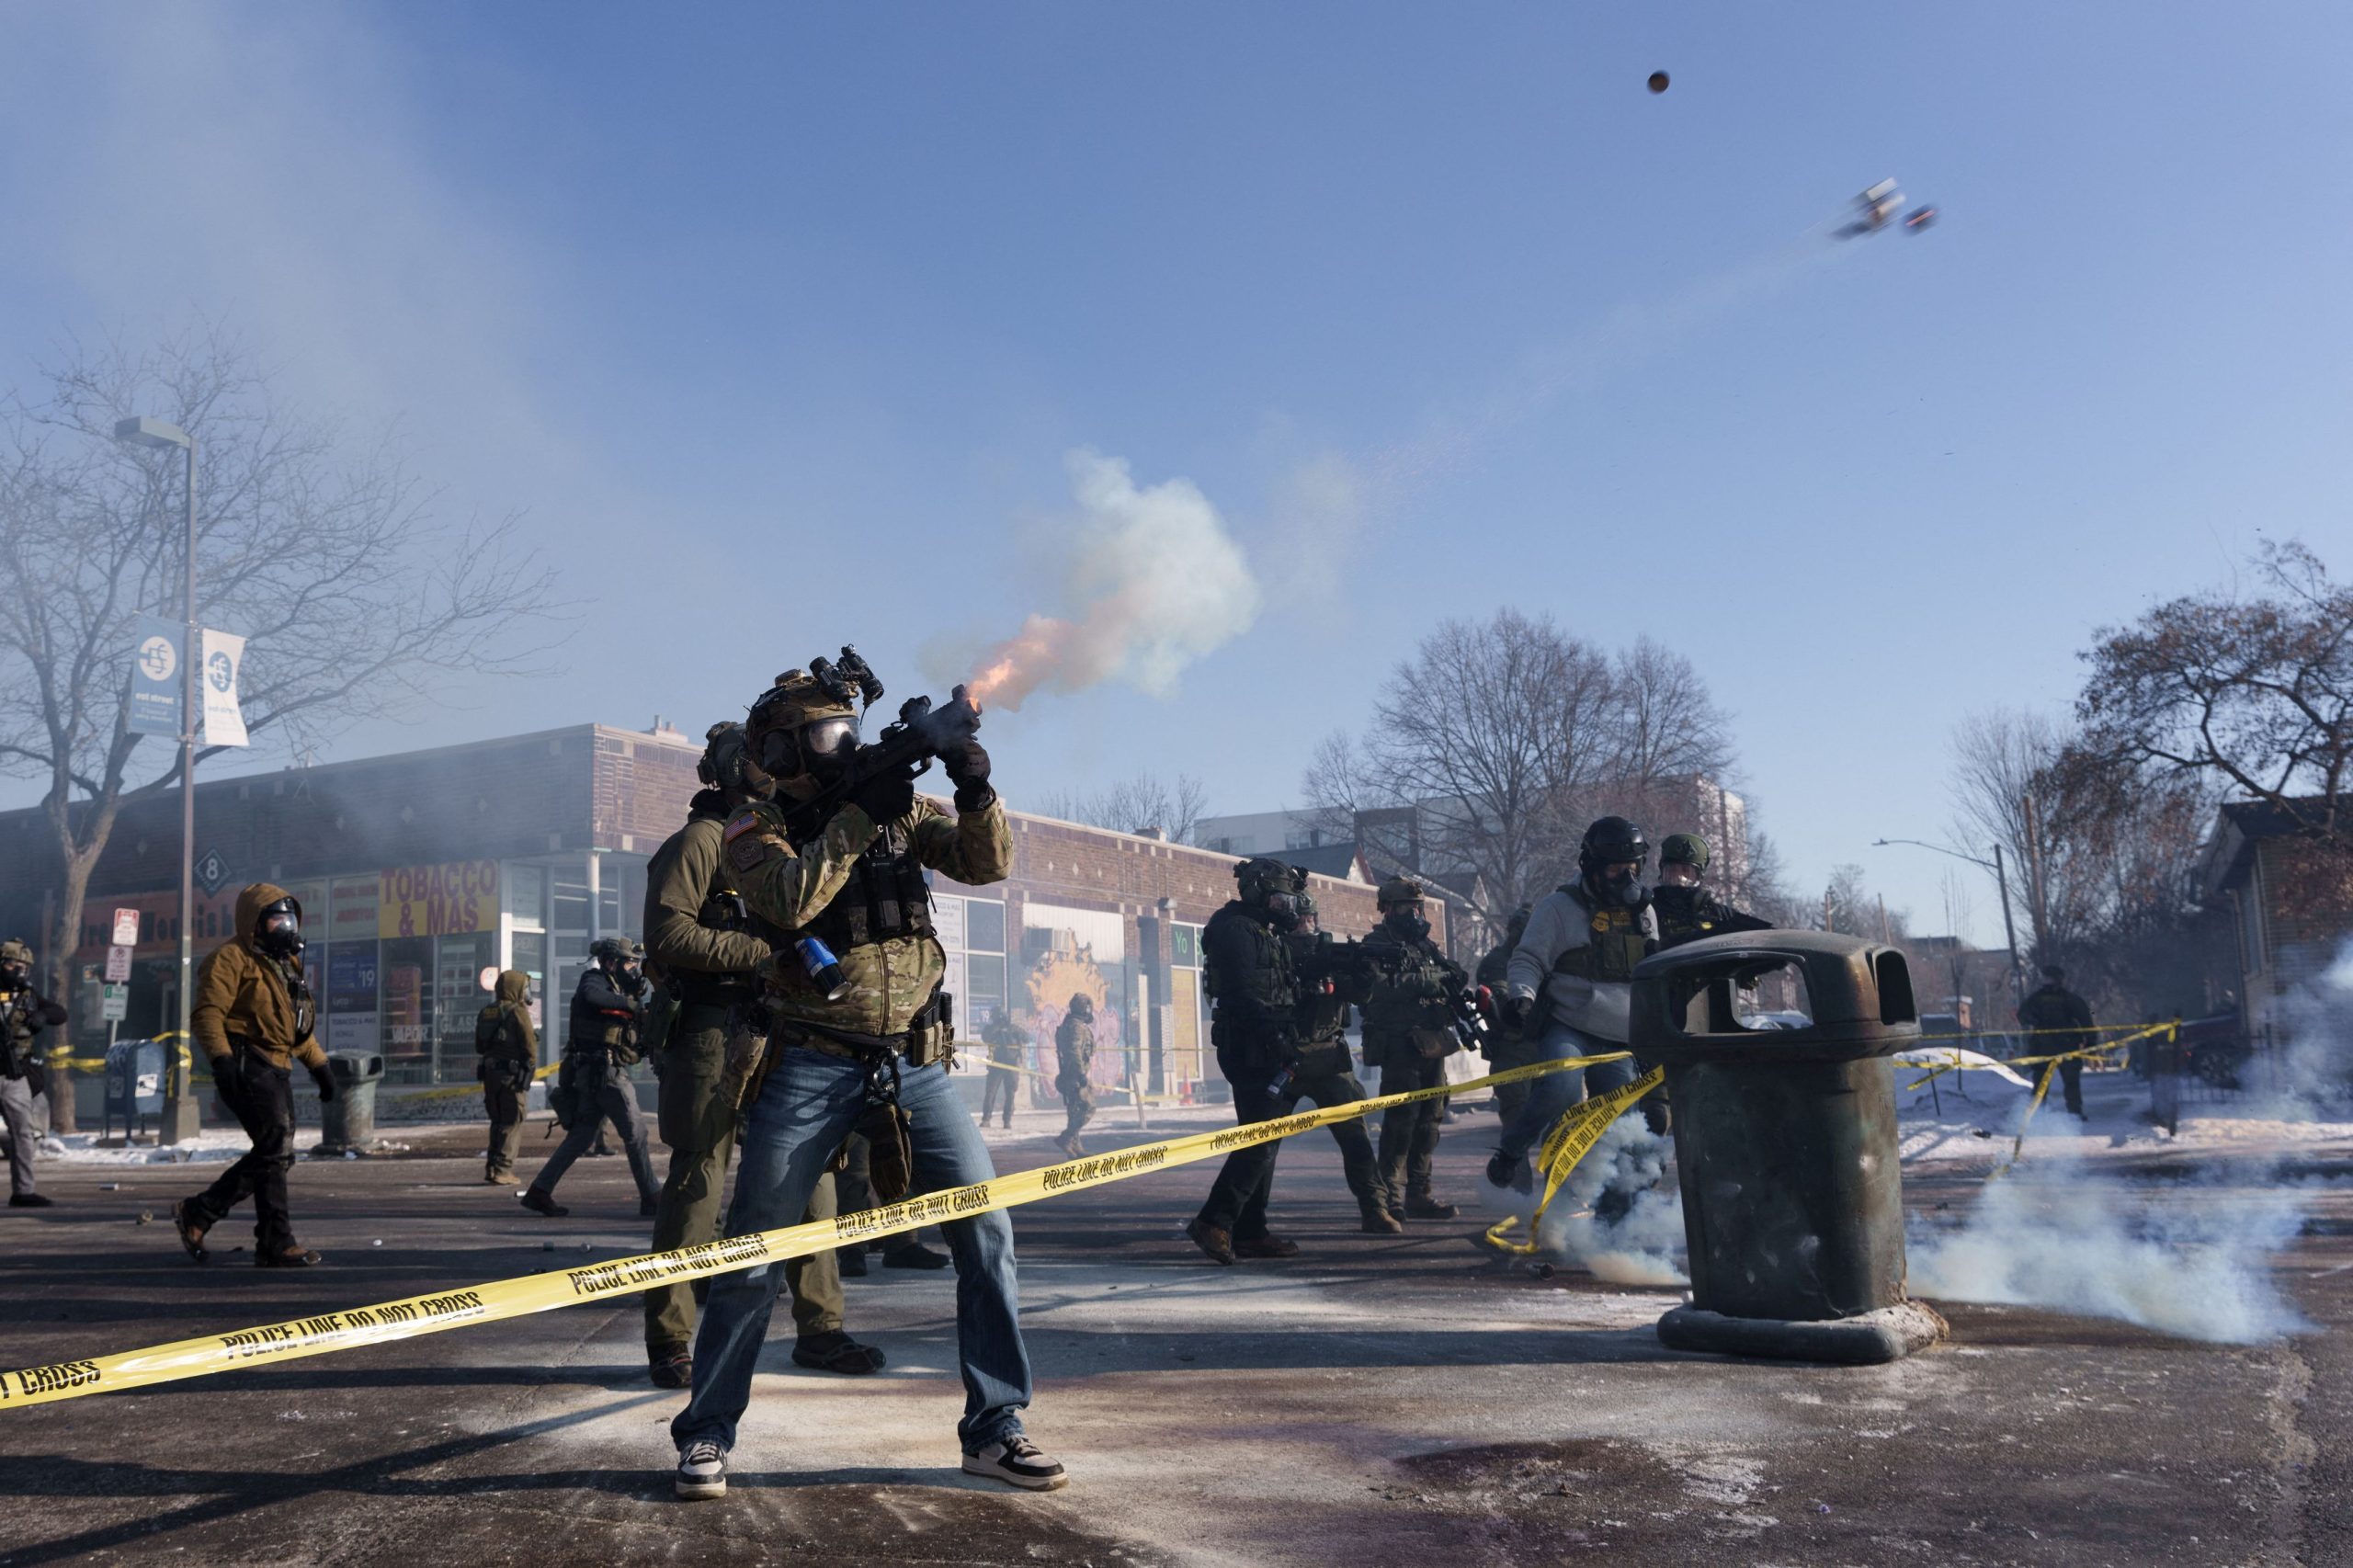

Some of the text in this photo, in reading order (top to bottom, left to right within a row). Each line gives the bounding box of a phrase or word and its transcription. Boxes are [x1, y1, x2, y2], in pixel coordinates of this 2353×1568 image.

[206, 858, 219, 881] 8
[381, 860, 496, 903] TOBACCO
[399, 903, 415, 937] &
[426, 897, 479, 936] MAS
[1176, 931, 1188, 955] Yo
[392, 1024, 428, 1044] VAPOR
[1624, 1072, 1658, 1095] CROSS
[1042, 1145, 1168, 1191] POLICE LINE DO NOT CROSS
[834, 1185, 990, 1240] POLICE LINE DO NOT CROSS
[567, 1264, 629, 1295] POLICE
[623, 1256, 665, 1284] LINE
[660, 1251, 688, 1275] DO
[686, 1244, 720, 1270] NOT
[219, 1291, 485, 1360] POLICE LINE DO NOT CROSS
[15, 1360, 101, 1396] CROSS
